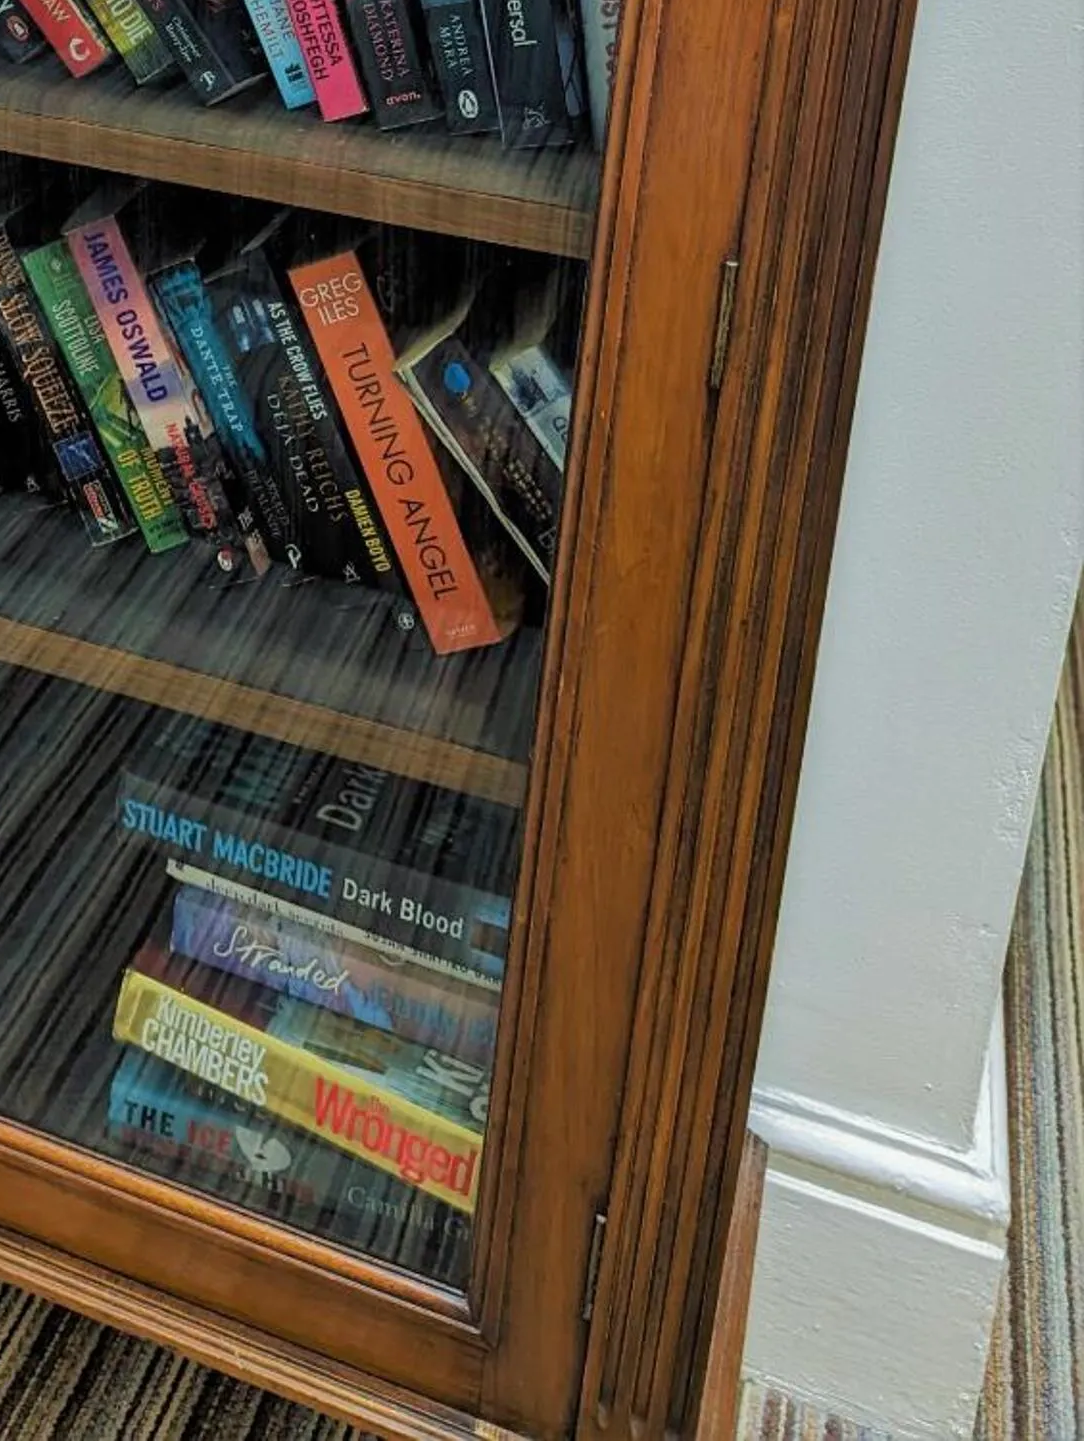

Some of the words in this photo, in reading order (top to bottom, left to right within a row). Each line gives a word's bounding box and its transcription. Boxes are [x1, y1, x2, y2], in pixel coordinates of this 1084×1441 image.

[120, 6, 155, 46] DIE
[362, 1, 395, 83] DIAMOND
[436, 24, 457, 69] MARA
[448, 13, 476, 78] ANDREA
[385, 89, 423, 106] avon.
[83, 231, 129, 306] JAMES
[116, 308, 166, 403] OSWALD
[267, 300, 286, 318] AS
[298, 271, 365, 309] GREG
[315, 298, 361, 328] ILES
[50, 298, 101, 377] SCOTTOLINE
[82, 314, 104, 344] LISA
[275, 317, 297, 346] THE
[20, 344, 82, 435] SQUEEZE
[189, 326, 225, 390] DANTE
[216, 389, 244, 433] TRAP
[219, 364, 238, 389] THE
[285, 344, 313, 382] CROW
[300, 380, 328, 420] FLIES
[117, 448, 137, 466] OF
[129, 470, 165, 521] TRUTH
[289, 453, 320, 514] DEAD
[304, 447, 349, 524] REICHS
[340, 341, 415, 487] TURNING
[398, 497, 460, 601] ANGEL
[343, 487, 377, 542] DAMIEN
[364, 539, 392, 574] BOYD
[316, 767, 389, 834] Dark
[120, 798, 208, 855] STUART
[210, 829, 335, 900] MACBRIDE
[341, 876, 394, 917] Dark
[398, 897, 466, 942] Blood
[213, 924, 352, 996] Stranded
[140, 1021, 272, 1108] CHAMBERS
[155, 993, 268, 1070] Kimberley
[123, 1100, 176, 1140] THE
[185, 1118, 233, 1153] ICE
[316, 1077, 477, 1199] Wronged
